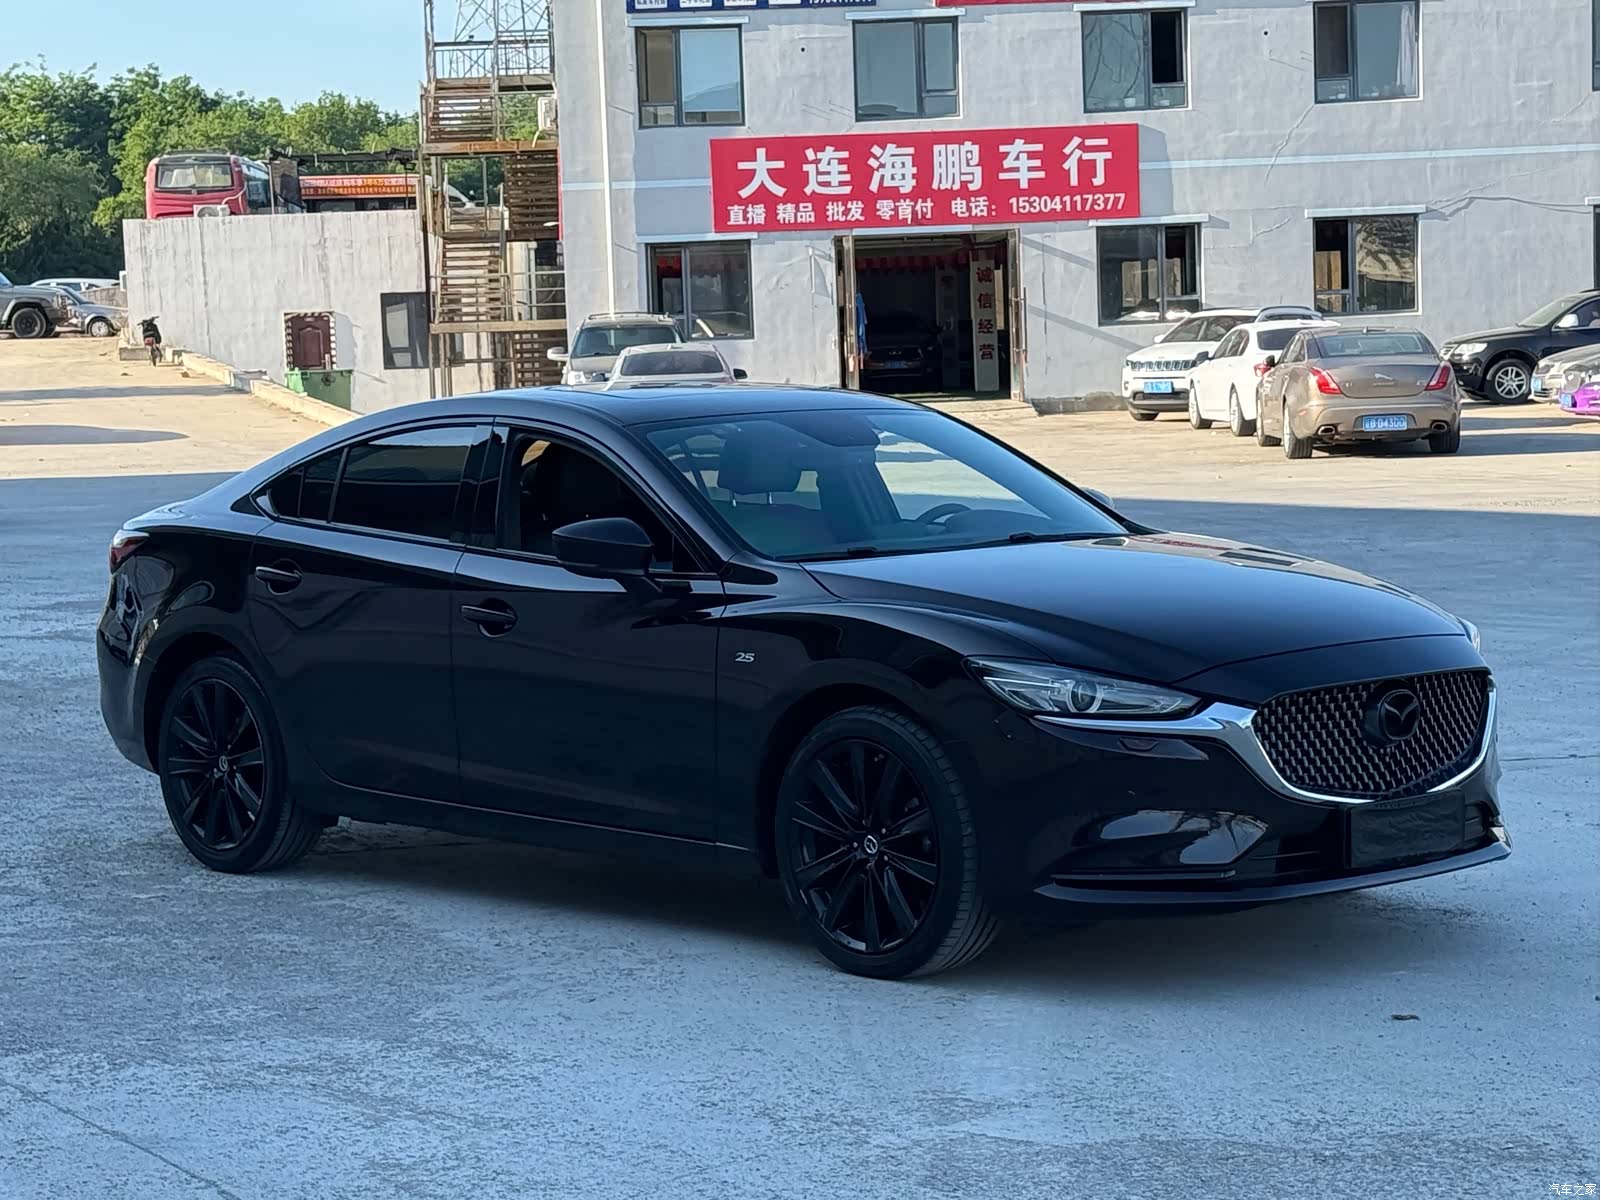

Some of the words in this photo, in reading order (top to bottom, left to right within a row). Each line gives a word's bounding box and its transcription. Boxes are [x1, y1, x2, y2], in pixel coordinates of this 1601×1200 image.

[736, 135, 1113, 199] 大连海鹏车行
[727, 204, 766, 225] 直播
[776, 202, 815, 224] 精品
[826, 200, 865, 222] 批发
[876, 198, 934, 222] 零首付
[1009, 193, 1126, 214] 15304117377
[976, 267, 994, 361] 诚信经营
[735, 652, 755, 663] 25
